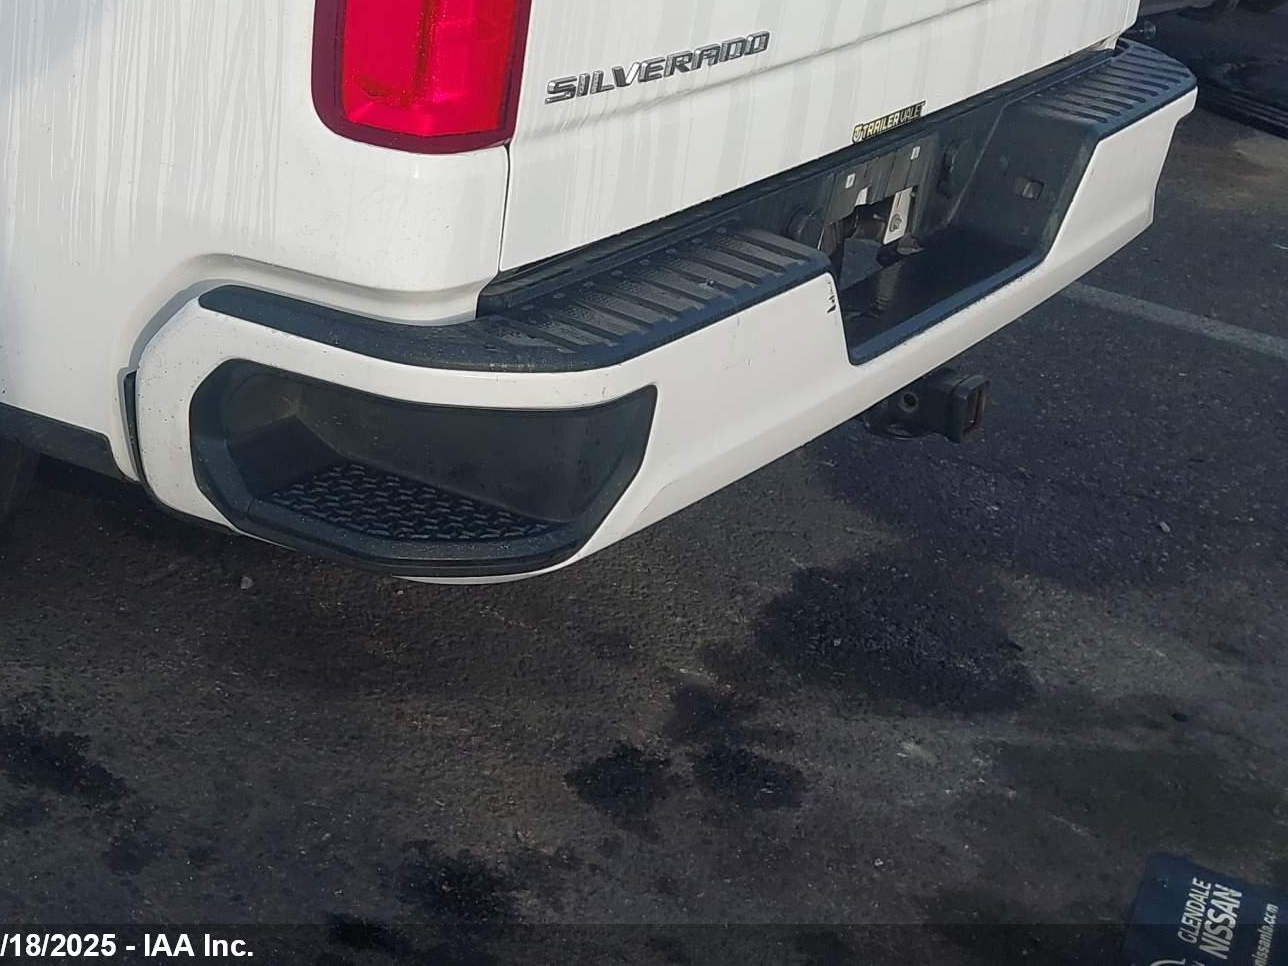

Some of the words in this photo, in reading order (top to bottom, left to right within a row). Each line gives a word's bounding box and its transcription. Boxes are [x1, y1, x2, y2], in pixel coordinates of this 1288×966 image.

[544, 30, 770, 105] SILVERADO
[1177, 877, 1212, 944] GLENDALE
[1199, 883, 1243, 960] NISSAN
